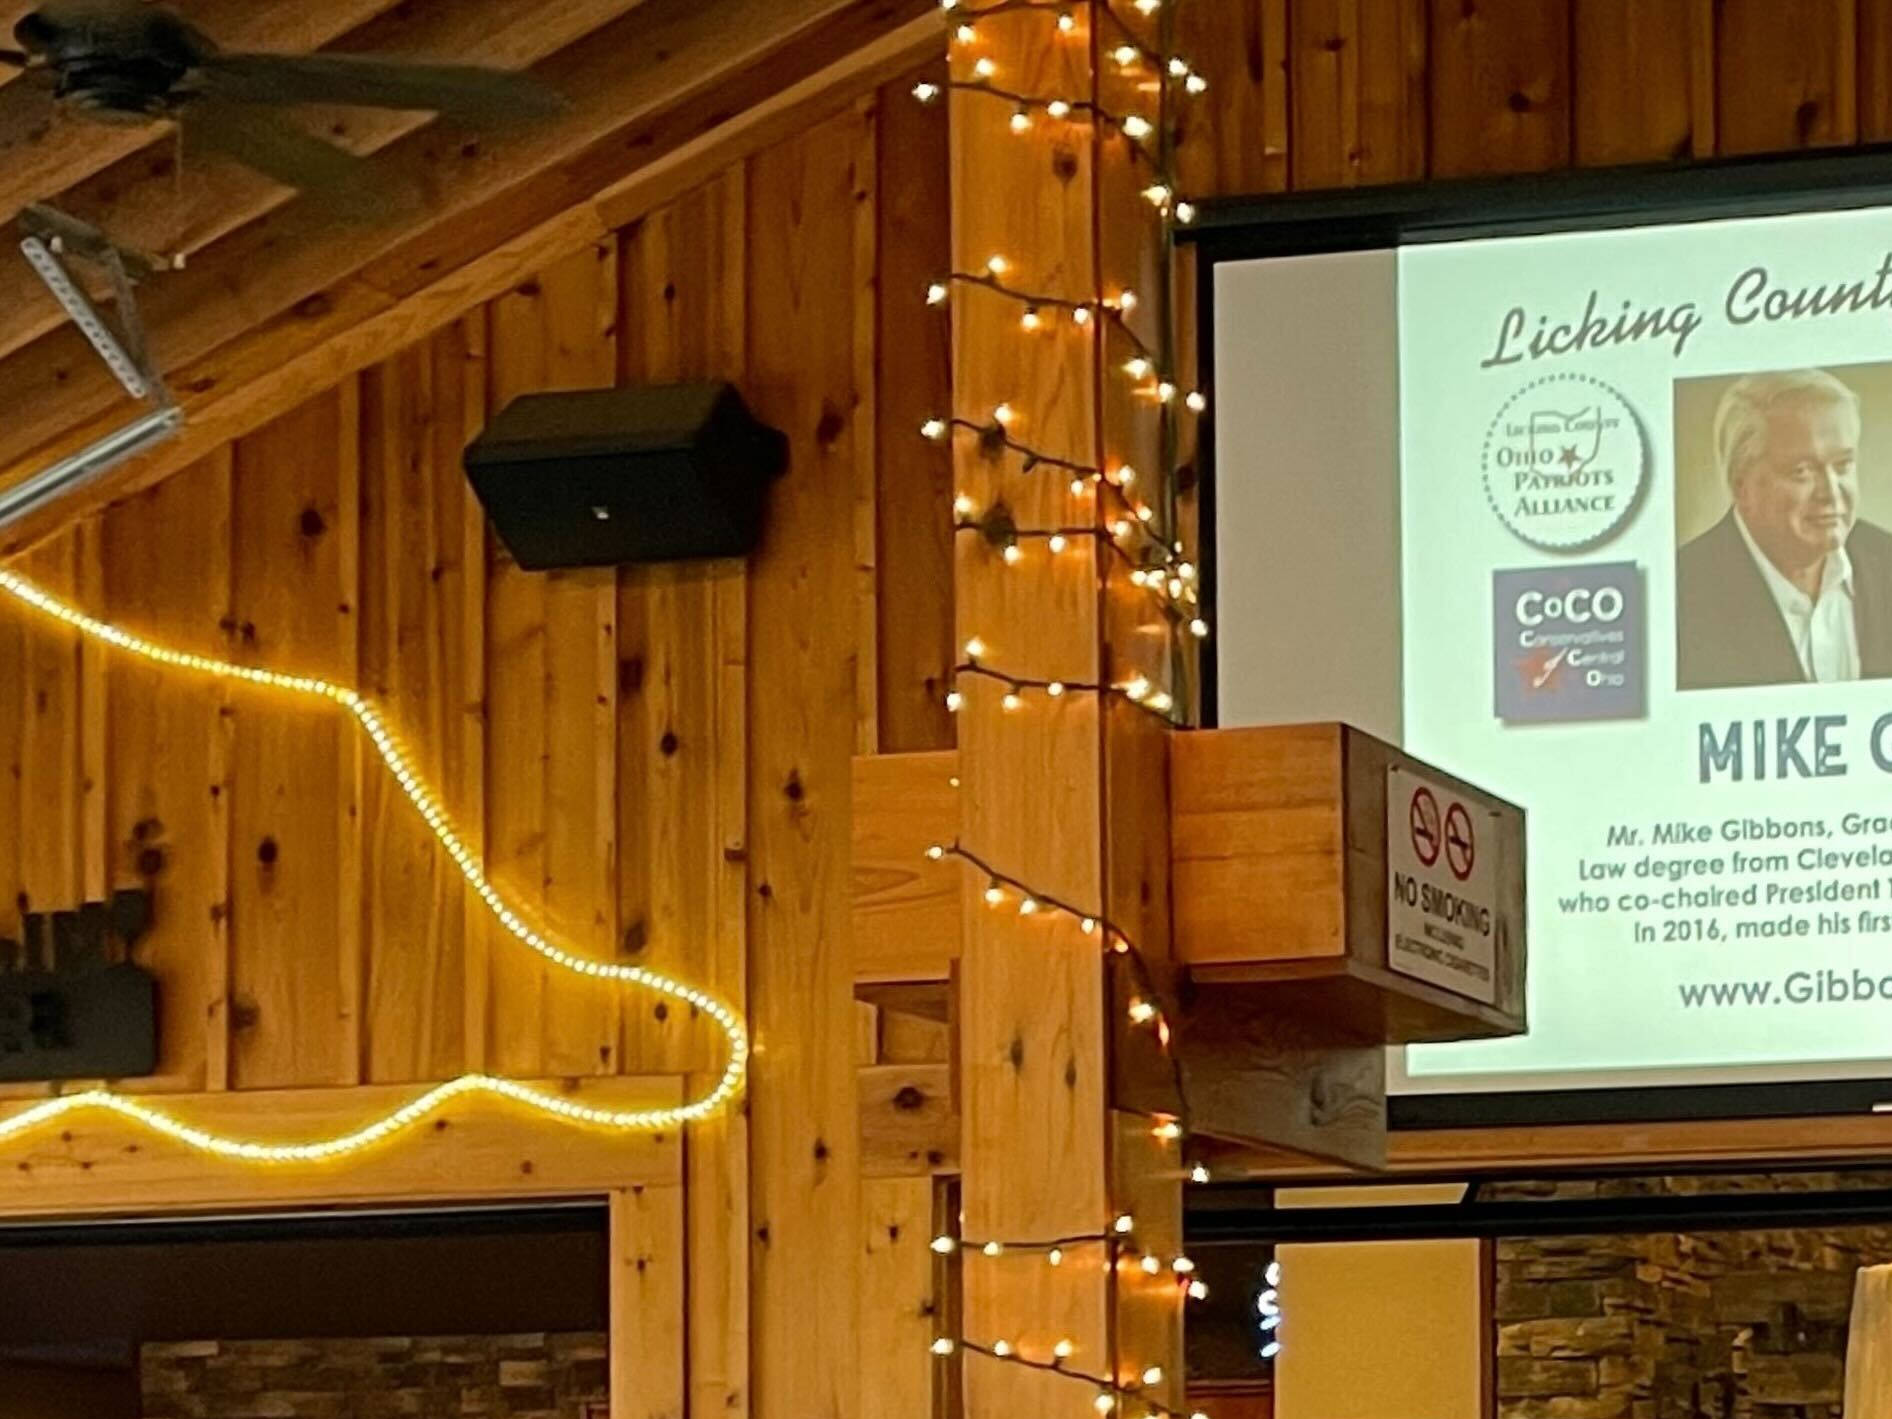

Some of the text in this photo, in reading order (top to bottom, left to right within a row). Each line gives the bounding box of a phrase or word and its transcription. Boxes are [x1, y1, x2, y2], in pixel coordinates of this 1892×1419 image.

[1481, 290, 1701, 368] Licking
[1514, 469, 1615, 491] PATRIOTS
[1514, 495, 1616, 517] ALLIANCE
[1699, 713, 1848, 784] MIKE
[1606, 824, 1645, 847] Mr.
[1652, 821, 1713, 846] Mike
[1721, 816, 1834, 842] Gibbons,
[1578, 859, 1626, 882] Law
[1634, 855, 1725, 882] degree
[1732, 851, 1789, 874] from
[1395, 871, 1417, 908] NO
[1421, 882, 1490, 937] SMOKING
[1558, 890, 1610, 914] who
[1617, 883, 1758, 911] co-chaired
[1766, 877, 1880, 904] President
[1663, 918, 1728, 943] 2016,
[1736, 914, 1810, 939] made
[1818, 911, 1851, 935] his
